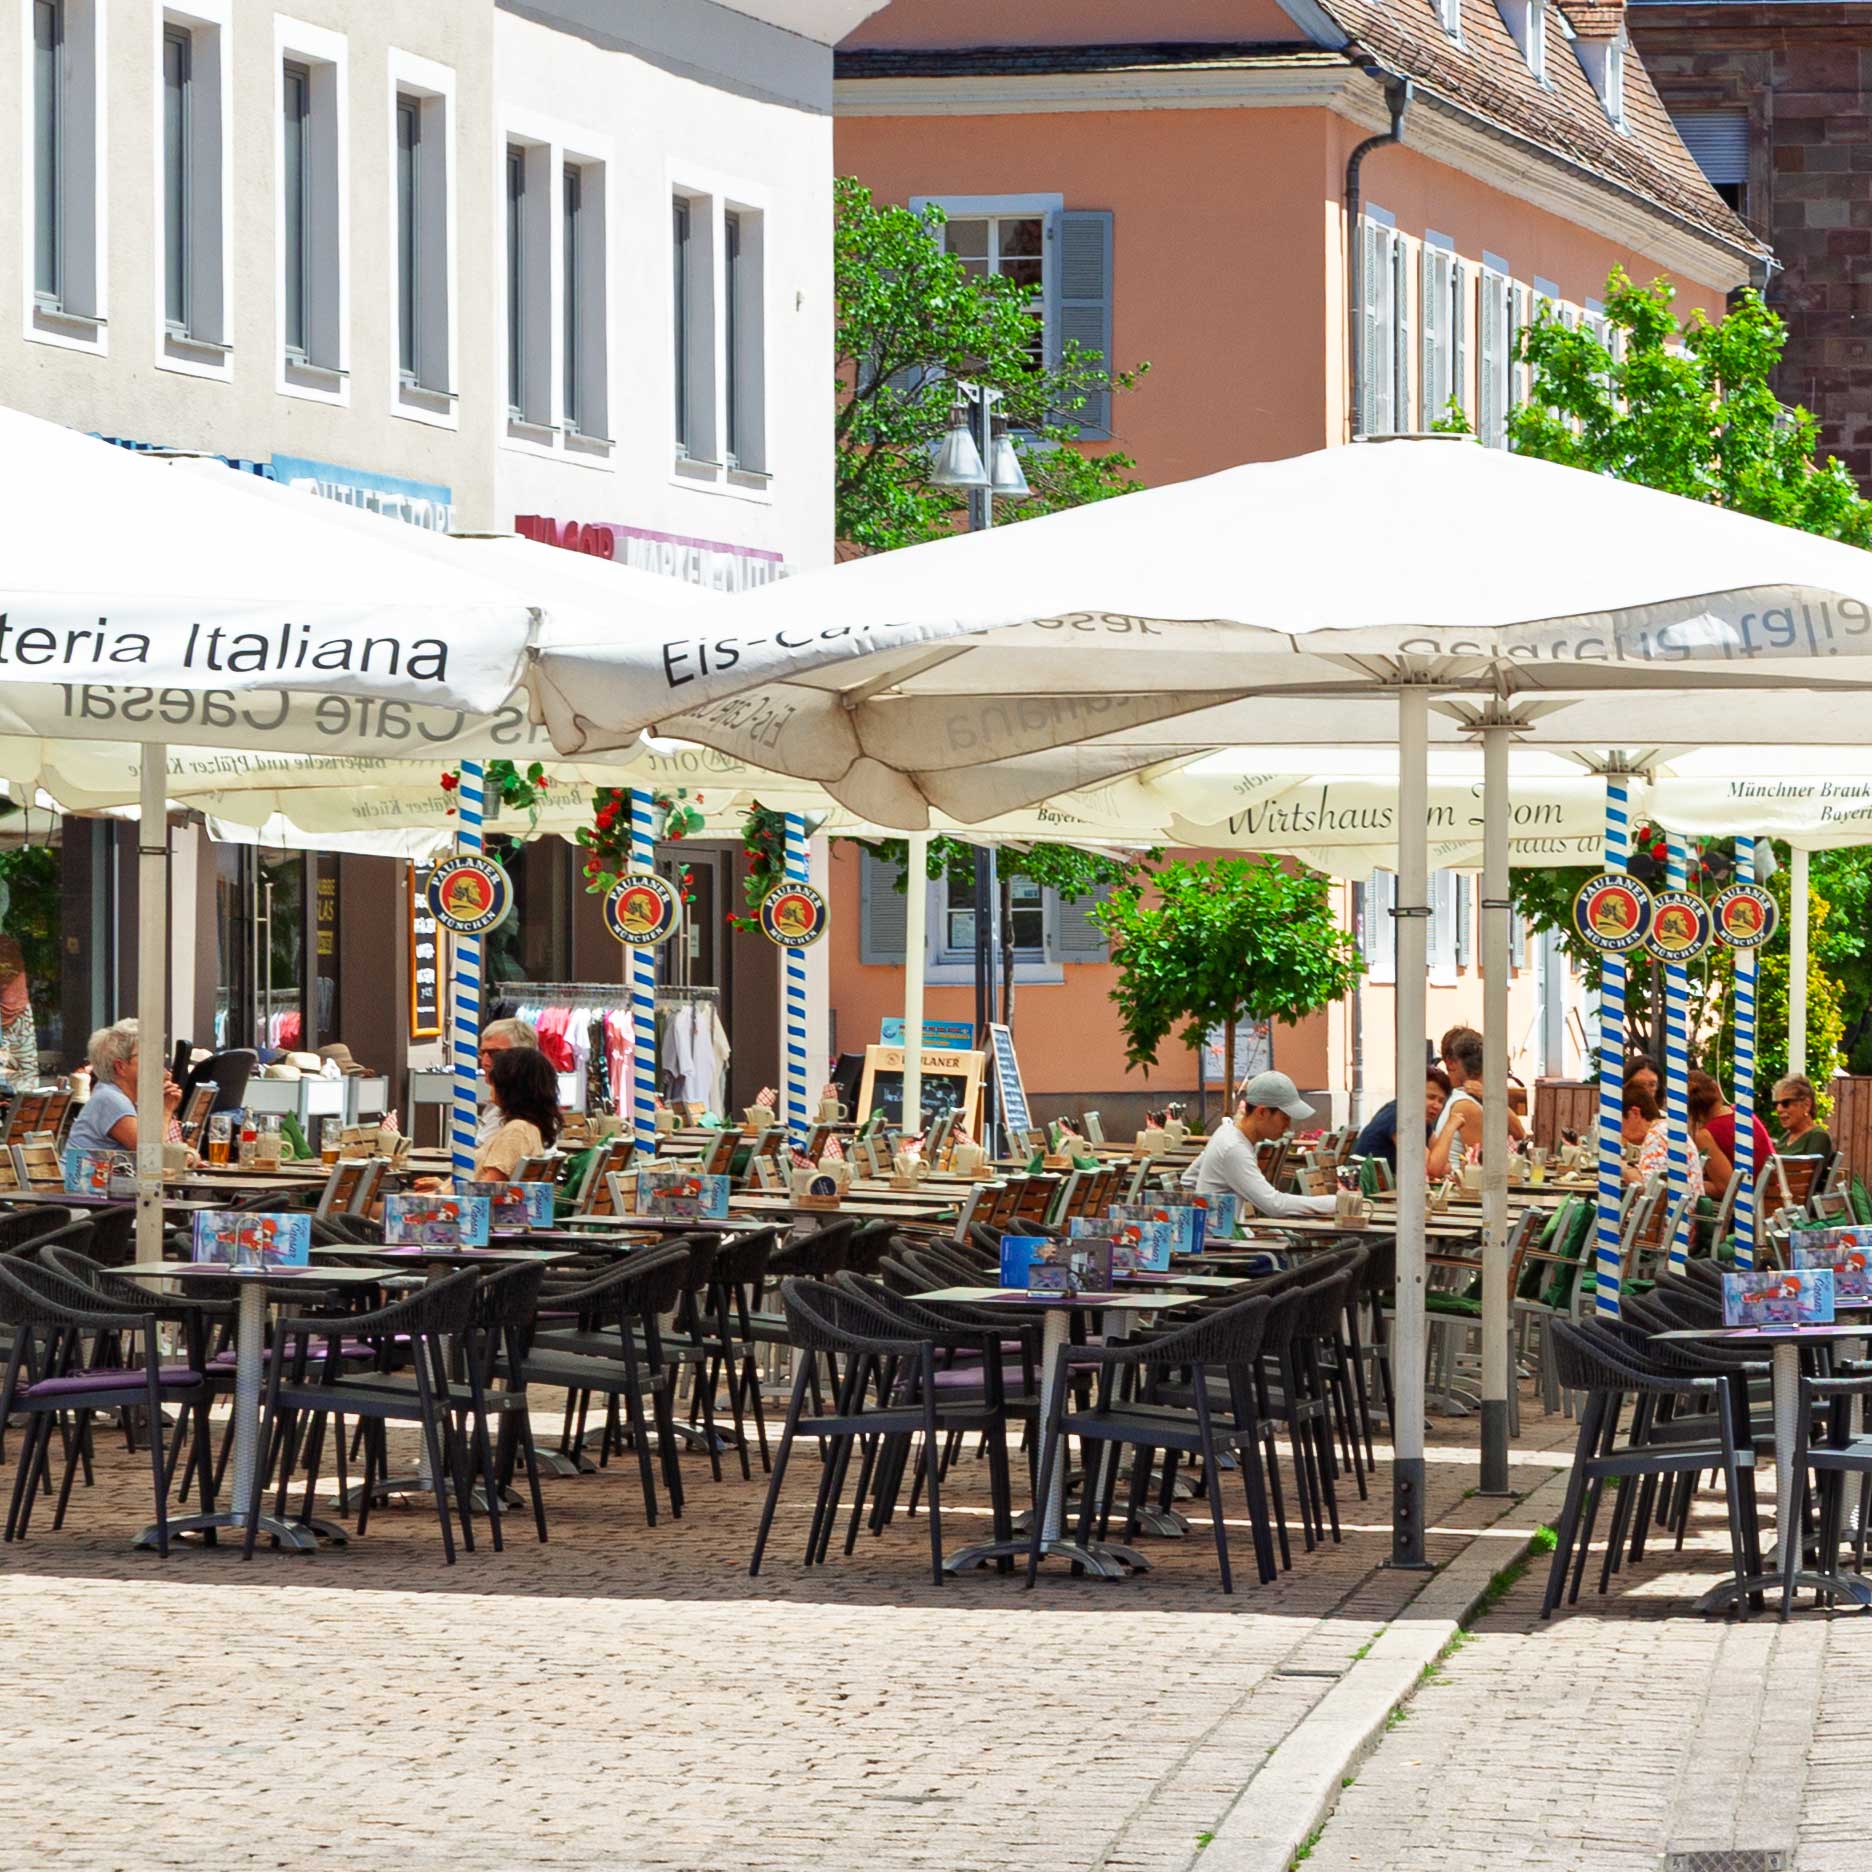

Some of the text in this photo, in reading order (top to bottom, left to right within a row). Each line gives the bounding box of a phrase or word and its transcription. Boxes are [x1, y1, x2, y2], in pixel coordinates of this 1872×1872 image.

[183, 621, 449, 682] Italiana
[1728, 781, 1815, 799] Münchner
[1227, 785, 1393, 836] Wirtshaus
[433, 857, 501, 887] PAULANER
[609, 877, 670, 904] PAULANER
[765, 885, 822, 909] PAULANER
[1579, 876, 1648, 905] PAULANER
[1715, 886, 1771, 910] PAULANER
[1654, 893, 1705, 917] ULANER
[902, 1054, 960, 1068] LANER
